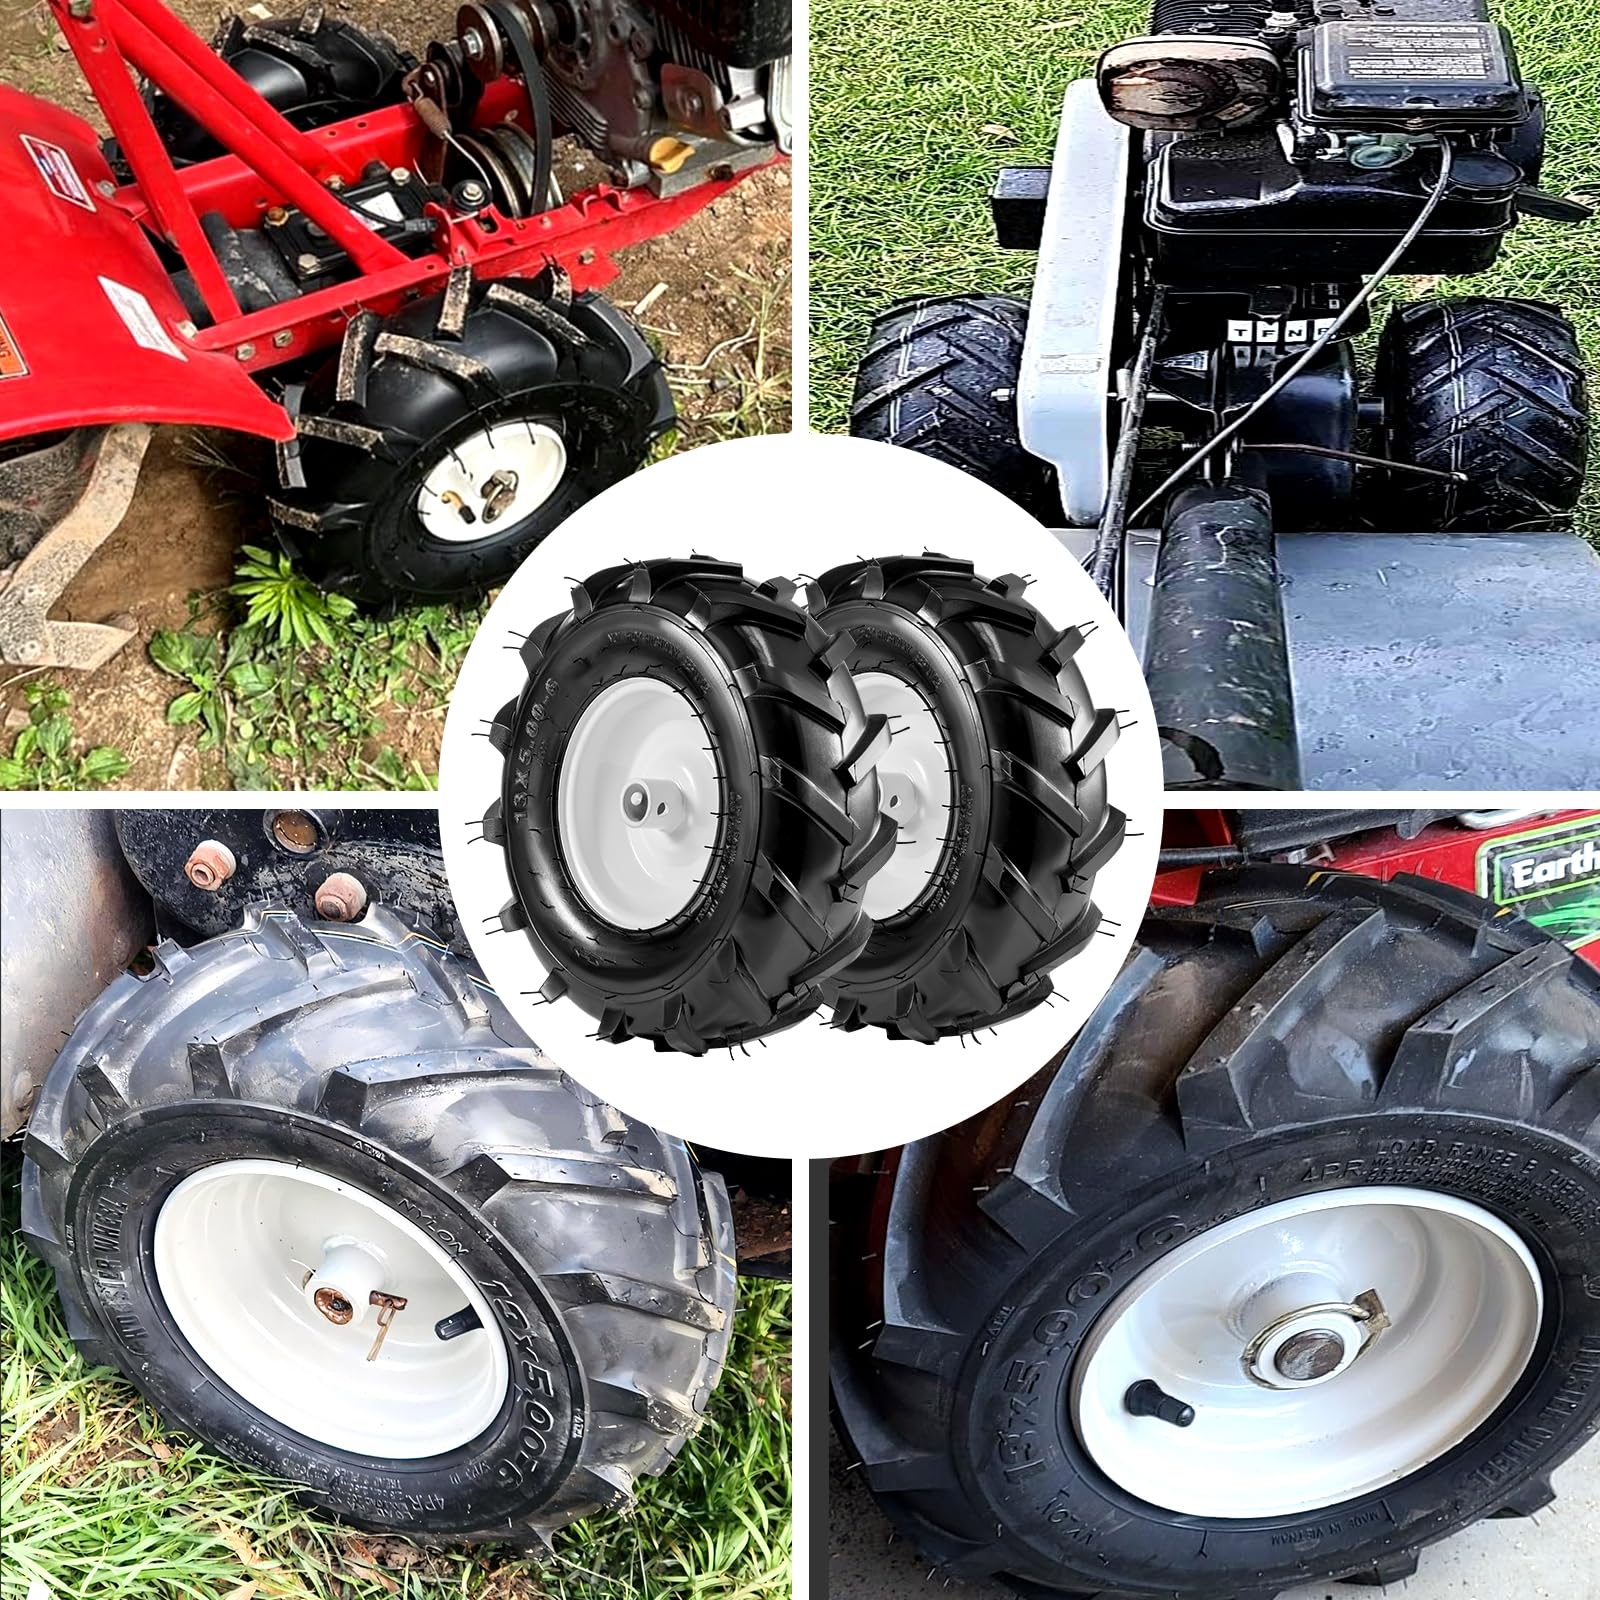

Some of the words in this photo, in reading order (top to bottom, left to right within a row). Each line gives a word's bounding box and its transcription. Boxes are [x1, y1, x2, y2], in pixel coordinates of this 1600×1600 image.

[1377, 1139, 1438, 1155] LOAD
[1449, 1141, 1518, 1168] RANGE
[399, 1198, 470, 1255] NYLON
